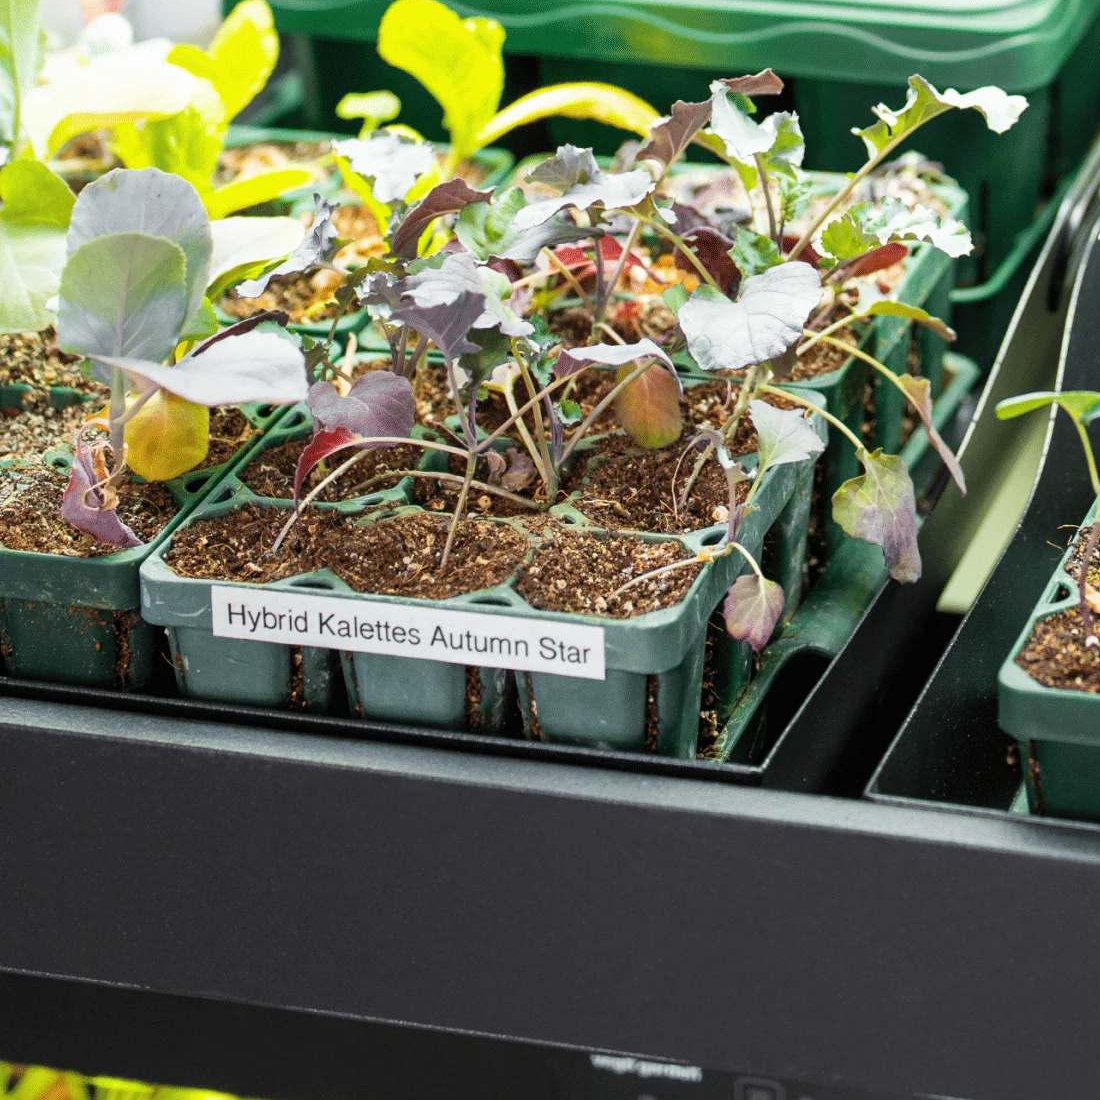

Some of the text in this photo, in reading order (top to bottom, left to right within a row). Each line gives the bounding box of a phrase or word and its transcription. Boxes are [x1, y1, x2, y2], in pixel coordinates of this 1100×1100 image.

[227, 603, 592, 665] Hybrid Kalettes Autumn Star
